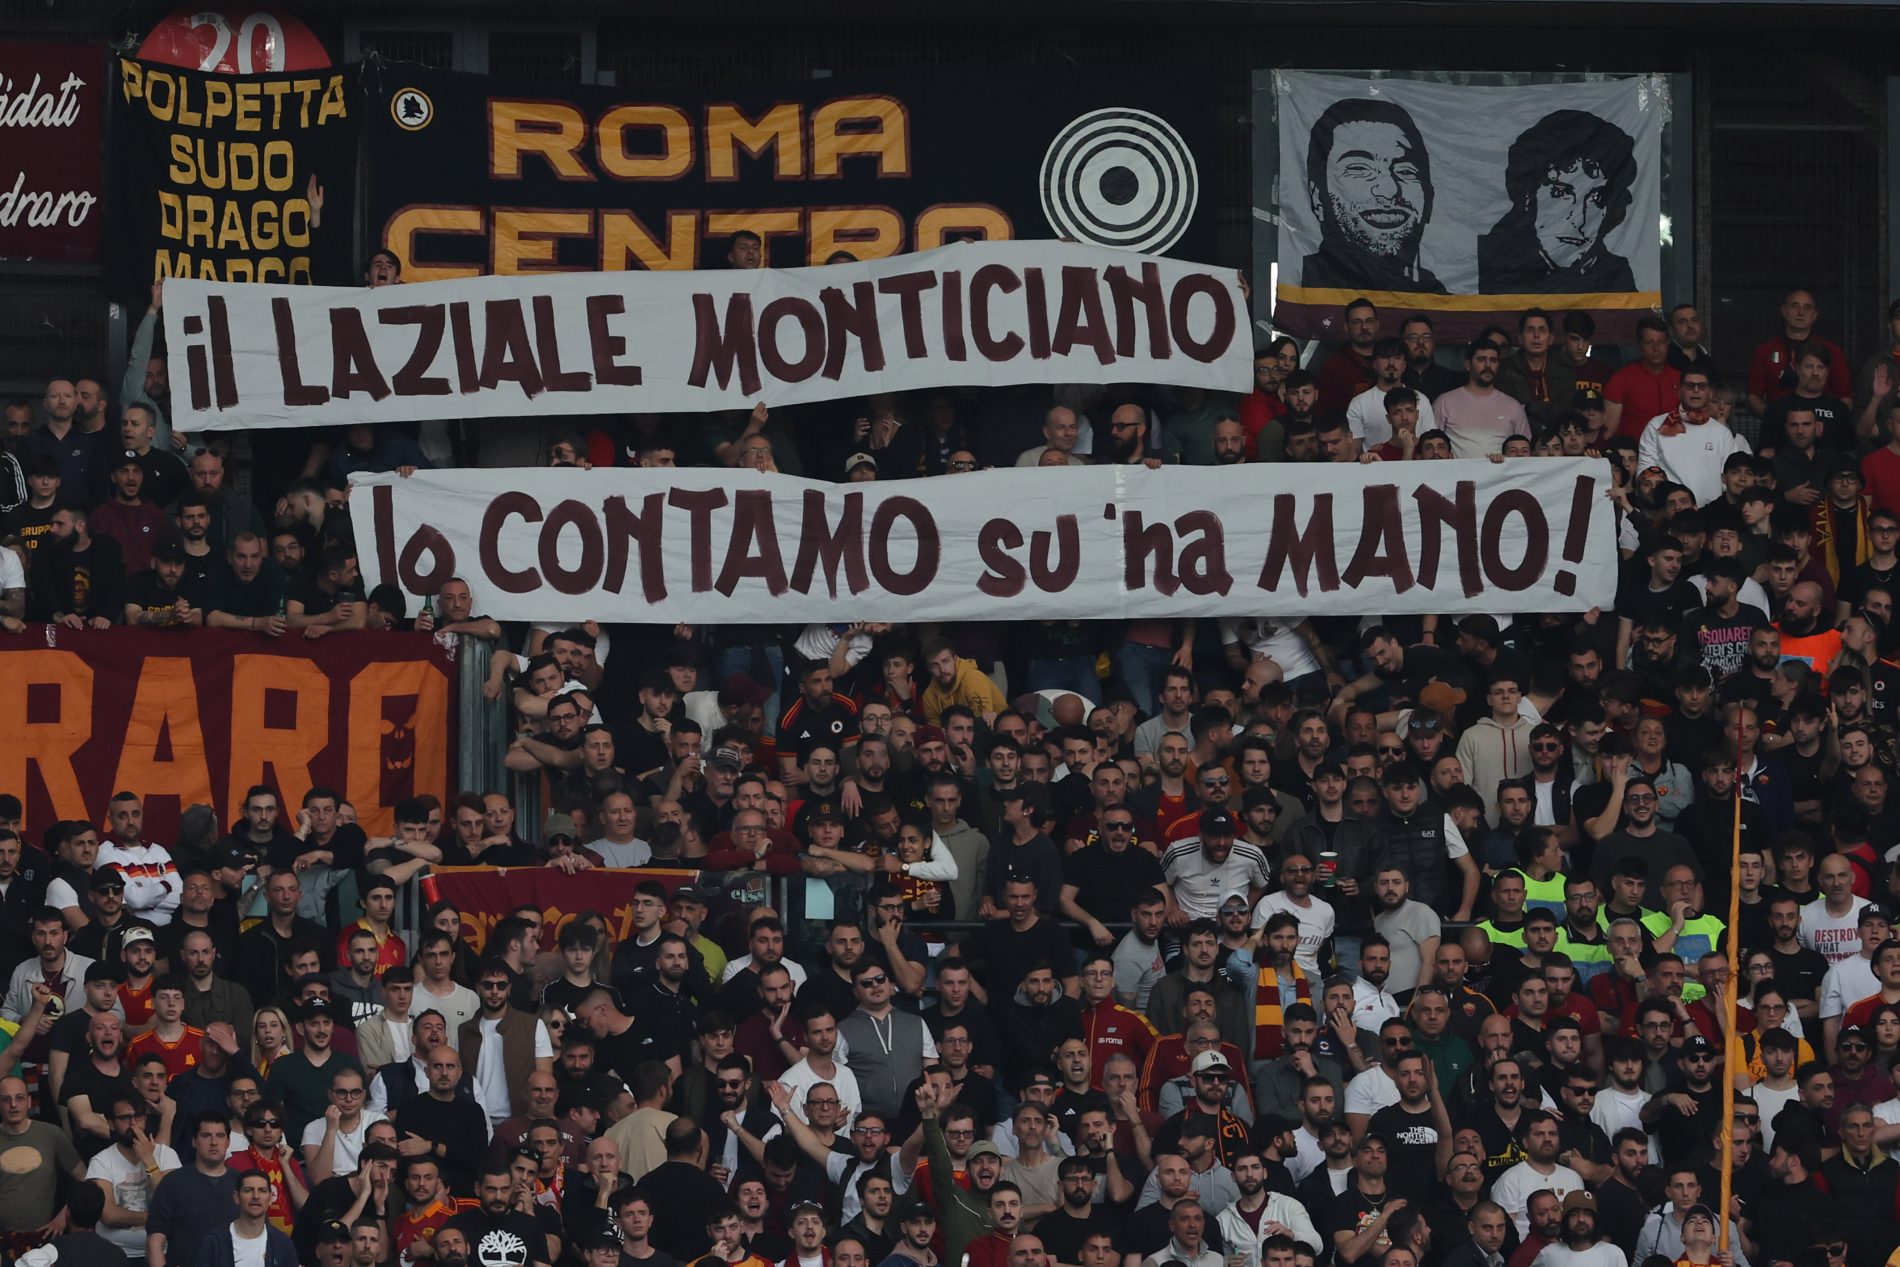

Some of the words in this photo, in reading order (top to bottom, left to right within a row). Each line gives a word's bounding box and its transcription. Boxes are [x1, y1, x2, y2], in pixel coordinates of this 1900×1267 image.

[191, 12, 286, 72] 20
[121, 59, 347, 132] POLPETTA
[169, 134, 294, 192] SUDO
[487, 94, 912, 182] ROMA
[158, 189, 311, 251] DRAGO
[271, 294, 642, 406] LAZIALE
[687, 262, 1236, 396] MONTICIANO
[479, 487, 942, 604] CONTAMO
[977, 514, 1081, 598] su
[1258, 475, 1596, 599] MANO!
[1815, 928, 1857, 943] DESTROY
[1815, 942, 1839, 954] WHAT
